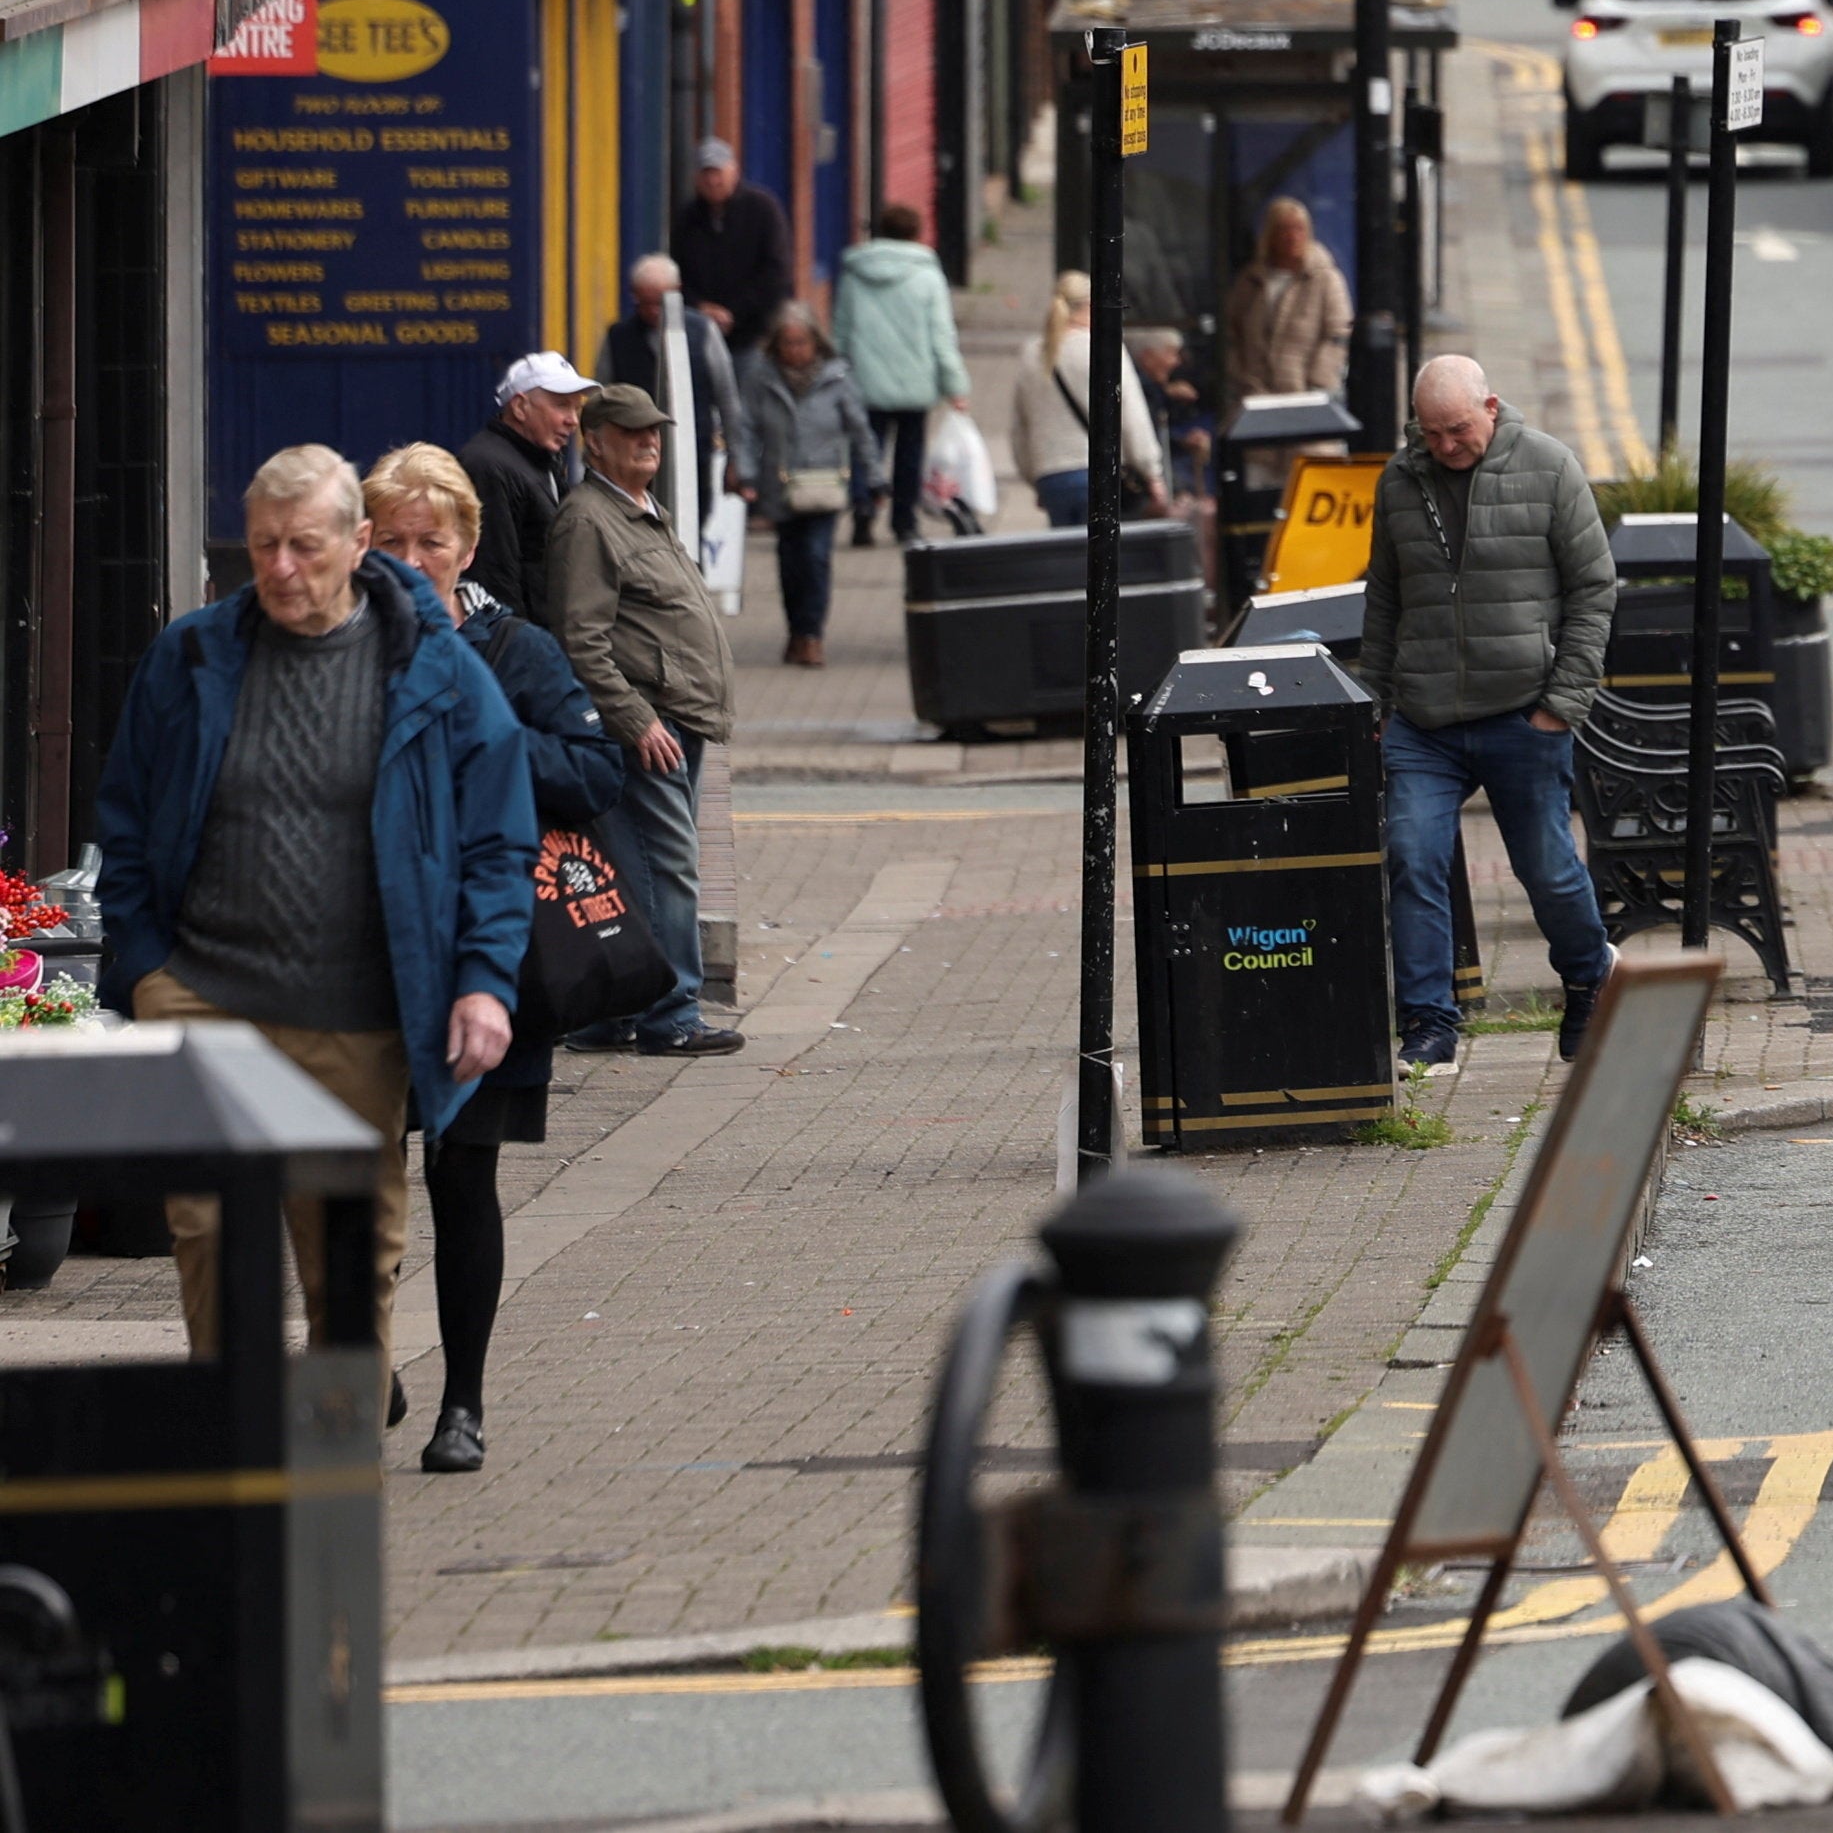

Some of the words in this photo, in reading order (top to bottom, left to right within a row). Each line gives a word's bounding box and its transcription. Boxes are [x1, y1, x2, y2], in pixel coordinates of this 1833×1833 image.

[1192, 29, 1292, 50] JCDecaux
[234, 127, 374, 152] HOUSEHOLD
[380, 127, 511, 152] ESSENTIALS
[236, 170, 338, 189] GIFTWARE
[407, 169, 511, 188] TOILETRIES
[234, 200, 364, 220] HOMEWARES
[405, 200, 511, 219] FURNITURE
[236, 230, 357, 251] STATIONERY
[422, 230, 511, 250] CANDLES
[233, 262, 325, 283] FLOWERS
[421, 261, 511, 281] LIGHTING
[236, 294, 322, 314] TEXTILES
[344, 293, 438, 313] GREETING
[444, 292, 511, 311] CARDS
[267, 323, 389, 346] SEASONAL
[395, 323, 478, 345] GOODS
[1227, 924, 1307, 953] Wigan
[1222, 946, 1314, 973] Council
